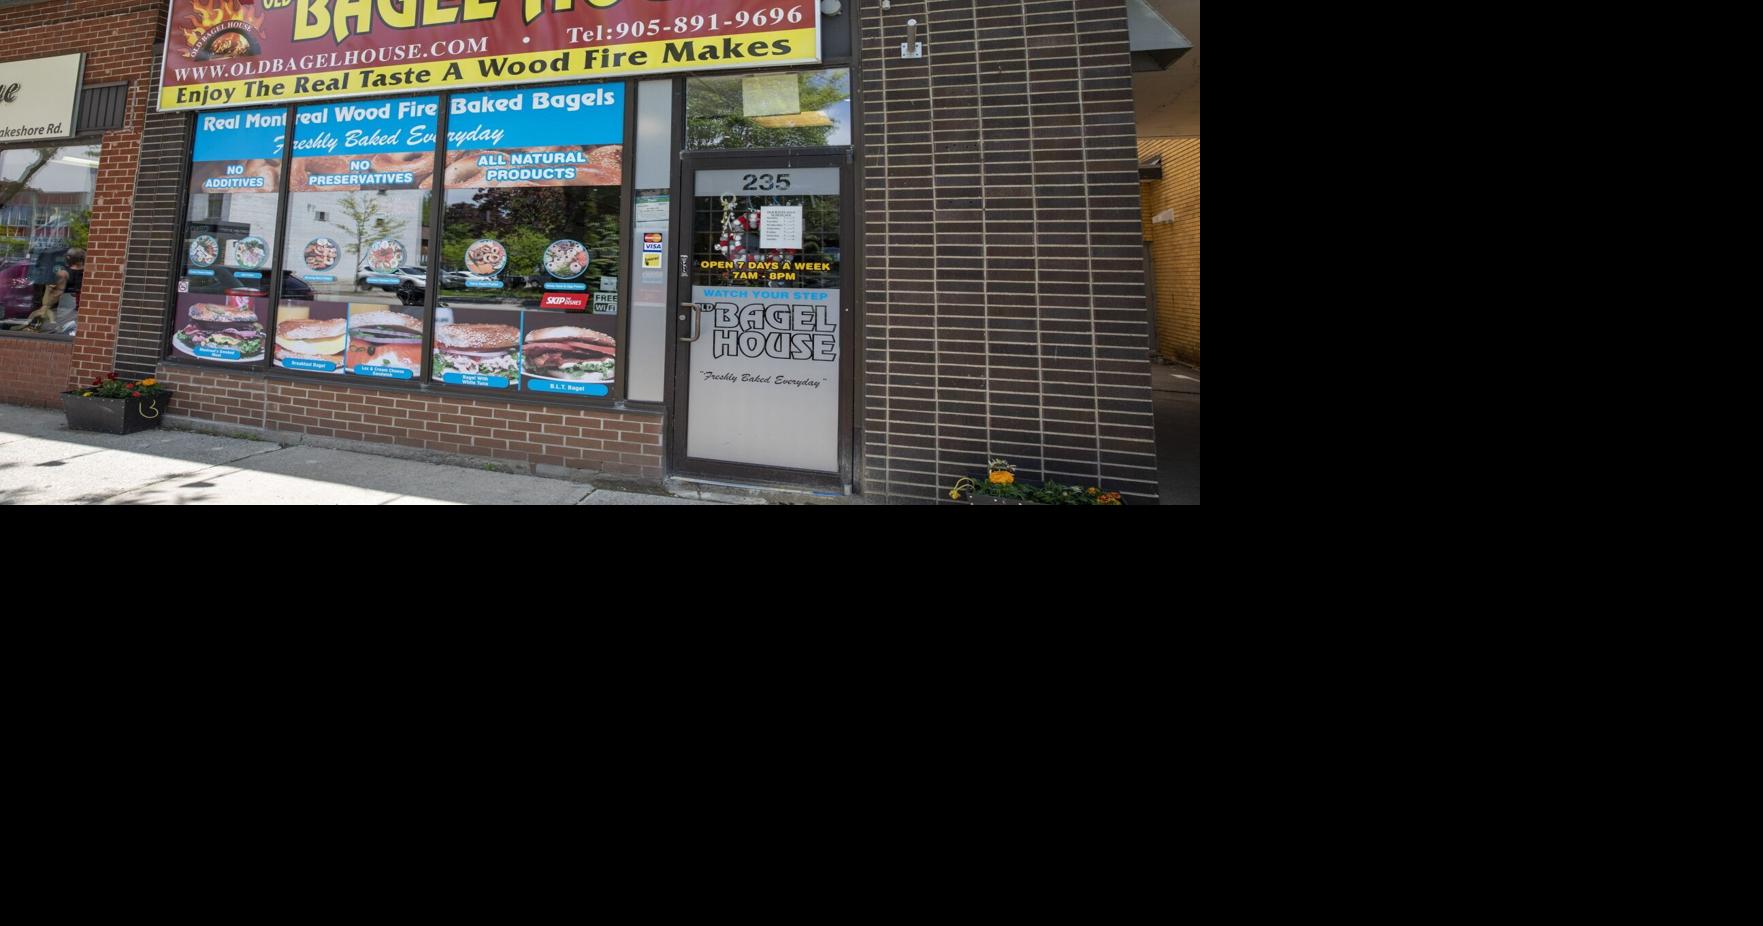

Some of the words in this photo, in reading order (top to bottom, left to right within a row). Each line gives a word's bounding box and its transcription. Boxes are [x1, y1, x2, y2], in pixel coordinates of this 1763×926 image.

[566, 5, 803, 44] Tel:905-891-9696
[174, 36, 489, 81] WWW.OLDBAGELHOUSE.COM
[176, 85, 236, 106] Enjoy
[244, 80, 286, 98] The
[294, 72, 349, 94] Real
[359, 67, 431, 88] Taste
[442, 62, 464, 81] A
[478, 51, 570, 78] Wood
[583, 48, 648, 70] Fire
[662, 37, 792, 64] Makes
[203, 114, 240, 132] Real
[334, 103, 391, 123] Wood
[397, 101, 438, 120] Fire
[451, 93, 523, 115] Baked
[531, 88, 615, 111] Bagels
[46, 122, 63, 135] Rd.
[344, 128, 402, 148] Baked
[350, 160, 370, 171] NO
[478, 154, 507, 166] ALL
[510, 152, 586, 165] NATURAL
[226, 165, 244, 175] NO
[487, 168, 575, 181] PRODUCTS
[205, 178, 265, 188] ADDITIVES
[308, 172, 413, 186] PRESERVATIVES
[742, 173, 791, 191] 235
[701, 261, 734, 269] OPEN
[738, 261, 745, 269] 7
[748, 262, 779, 270] DAYS
[783, 262, 791, 270] A
[794, 262, 831, 271] WEEK
[732, 272, 758, 280] 7AM
[769, 272, 796, 281] 8PM
[546, 296, 565, 305] SKIP
[703, 289, 748, 299] WATCH
[752, 290, 789, 299] YOUR
[793, 291, 828, 301] STEP
[715, 302, 837, 332] BAGEL
[713, 329, 837, 362] HOUSE
[741, 373, 771, 384] Baked
